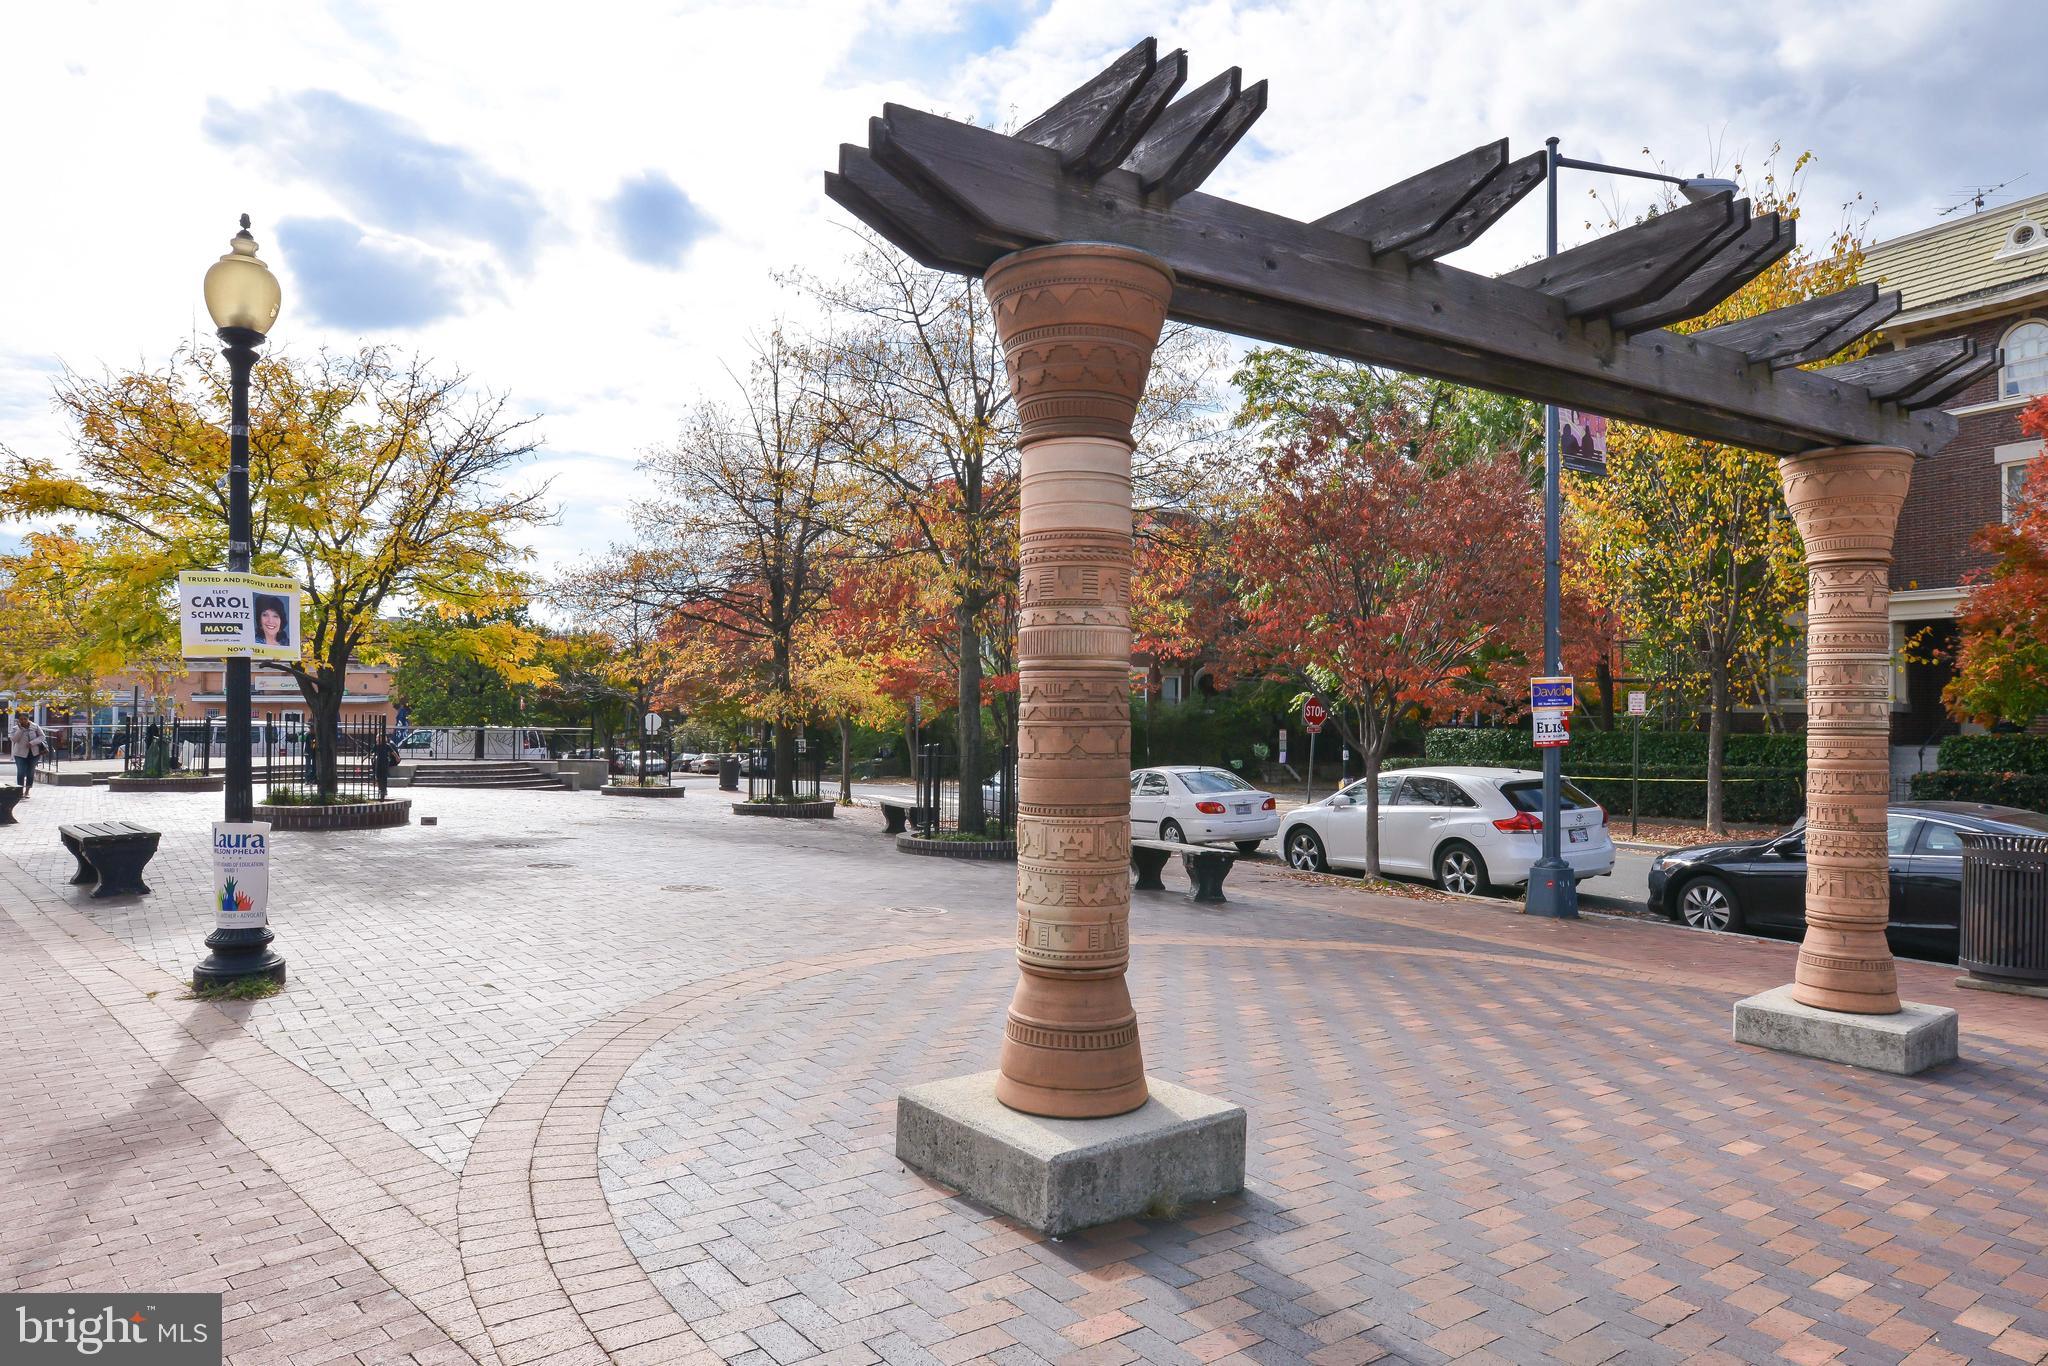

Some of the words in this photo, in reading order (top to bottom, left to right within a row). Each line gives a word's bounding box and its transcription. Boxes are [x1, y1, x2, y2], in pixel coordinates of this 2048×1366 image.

[242, 578, 265, 588] PROVEN
[267, 580, 293, 590] LEADER
[191, 596, 249, 609] CAROL
[191, 611, 251, 620] SCHWARTZ
[204, 625, 240, 633] MAYOR
[213, 828, 265, 849] Laura
